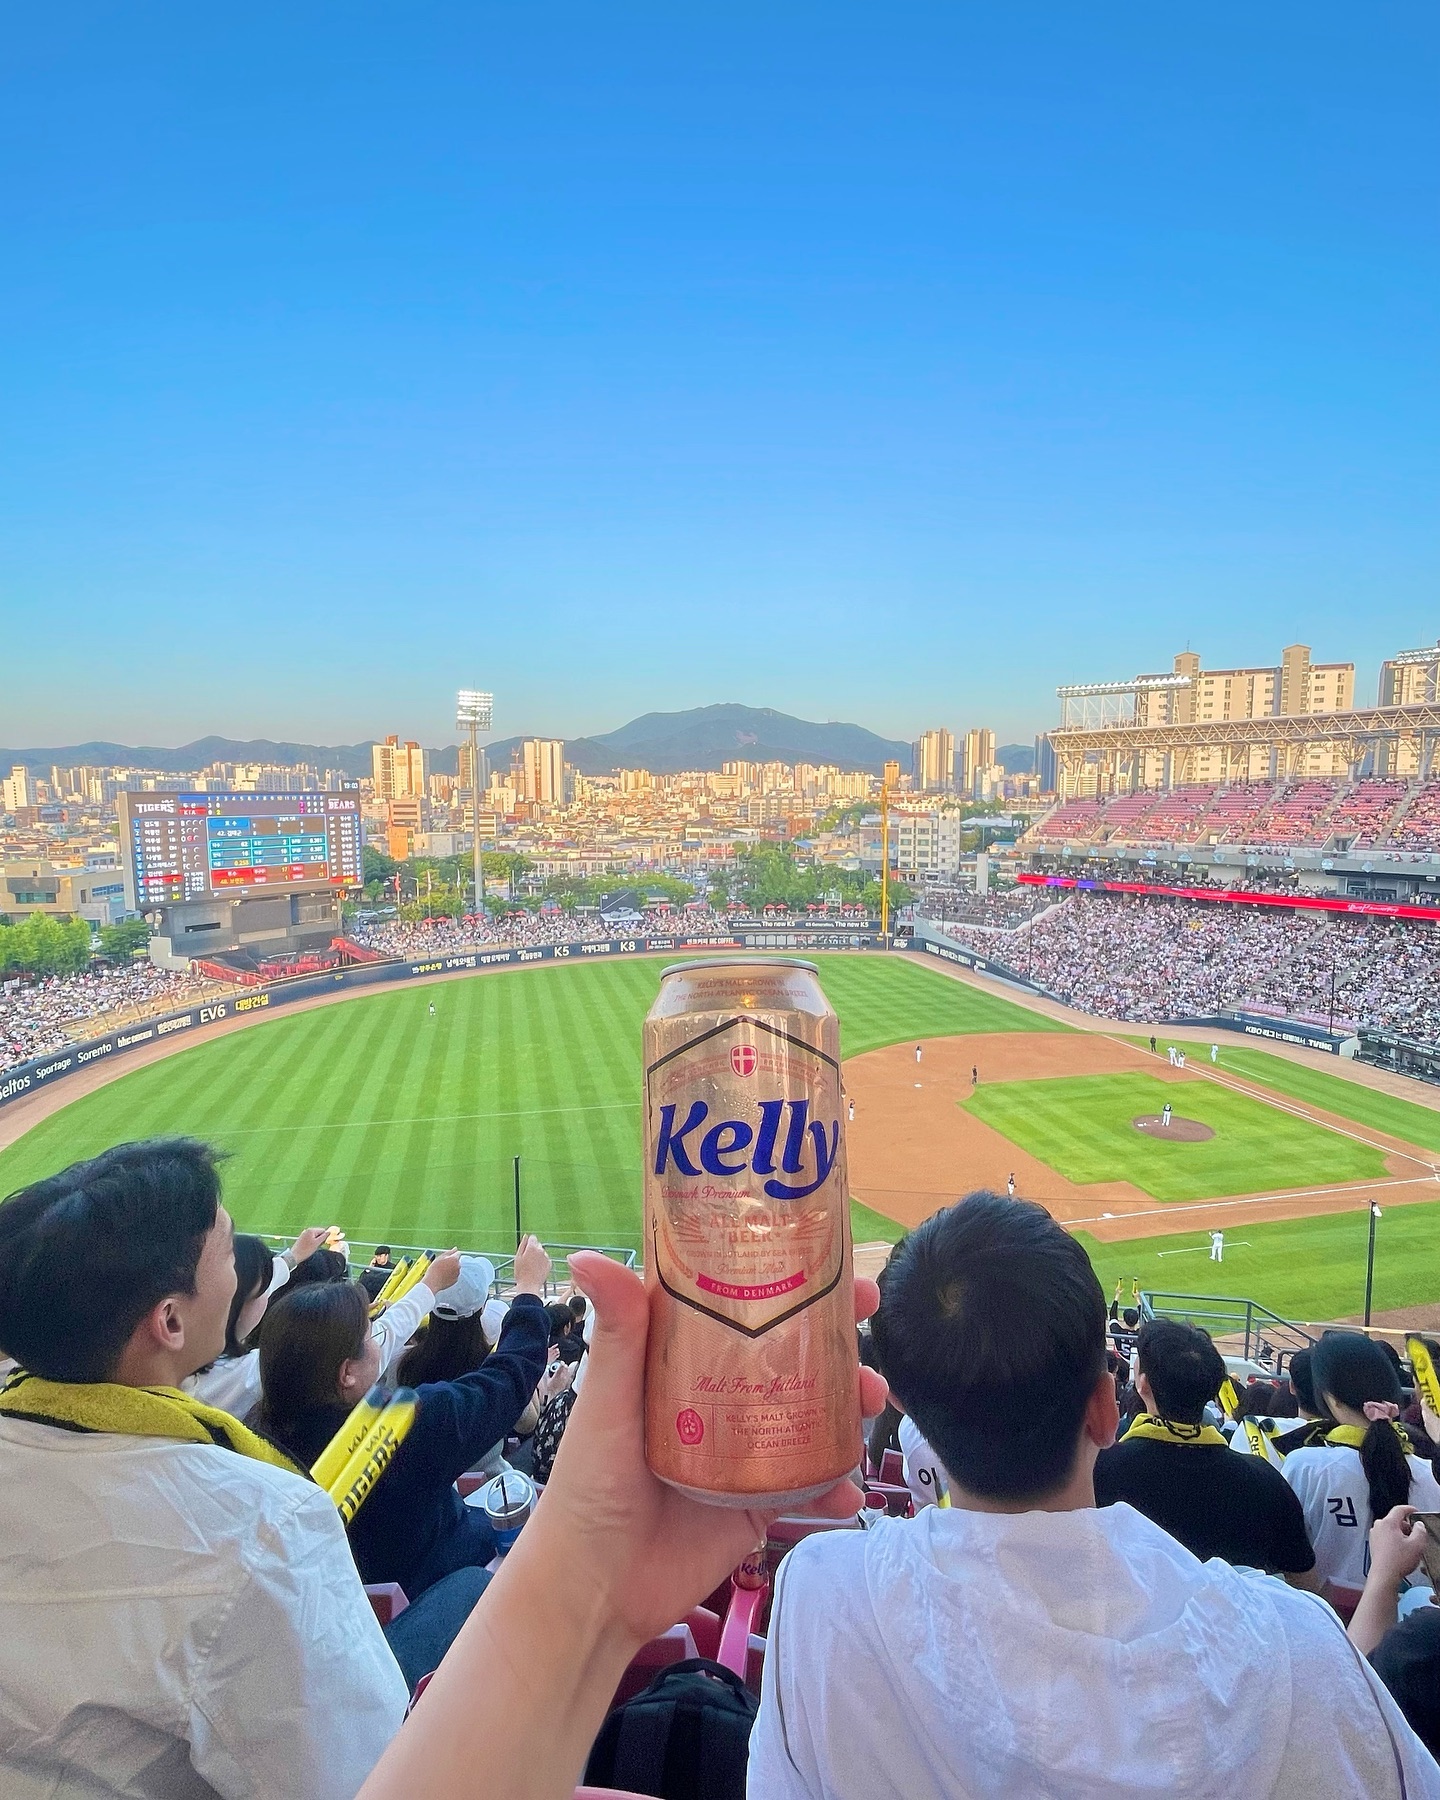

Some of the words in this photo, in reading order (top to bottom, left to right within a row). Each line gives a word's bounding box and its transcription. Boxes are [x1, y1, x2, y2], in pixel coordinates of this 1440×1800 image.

[134, 803, 174, 814] TIGERS
[328, 800, 355, 810] BEARS
[554, 946, 570, 957] K5
[620, 941, 636, 952] K8
[687, 991, 714, 1000] NORTH
[756, 989, 786, 997] OCEAN
[235, 993, 269, 1012] 대방건설
[199, 1004, 226, 1024] EV6
[1245, 1025, 1262, 1035] KBO
[77, 1043, 112, 1064] Sorento
[36, 1058, 72, 1079] Sportage
[0, 1075, 31, 1101] eltos
[655, 1099, 839, 1200] Kelly
[701, 1185, 751, 1199] Premium
[710, 1214, 740, 1228] ALL
[744, 1213, 790, 1229] MALT
[728, 1230, 773, 1243] BEER
[716, 1263, 756, 1276] Premium
[710, 1281, 738, 1297] FROM
[743, 1280, 793, 1298] DENMARK
[690, 1375, 726, 1393] Malt
[725, 1377, 764, 1394] From
[763, 1368, 819, 1399] Jutland
[725, 1413, 759, 1424] KELLY'S
[761, 1411, 785, 1422] MALT
[786, 1409, 817, 1420] GROWN
[730, 1426, 749, 1436] THE
[751, 1426, 782, 1436] NORTH
[783, 1421, 822, 1434] ATLANTIC
[747, 1439, 780, 1450] OCEAN
[781, 1436, 811, 1447] BREEZE
[1327, 1496, 1358, 1527] 김
